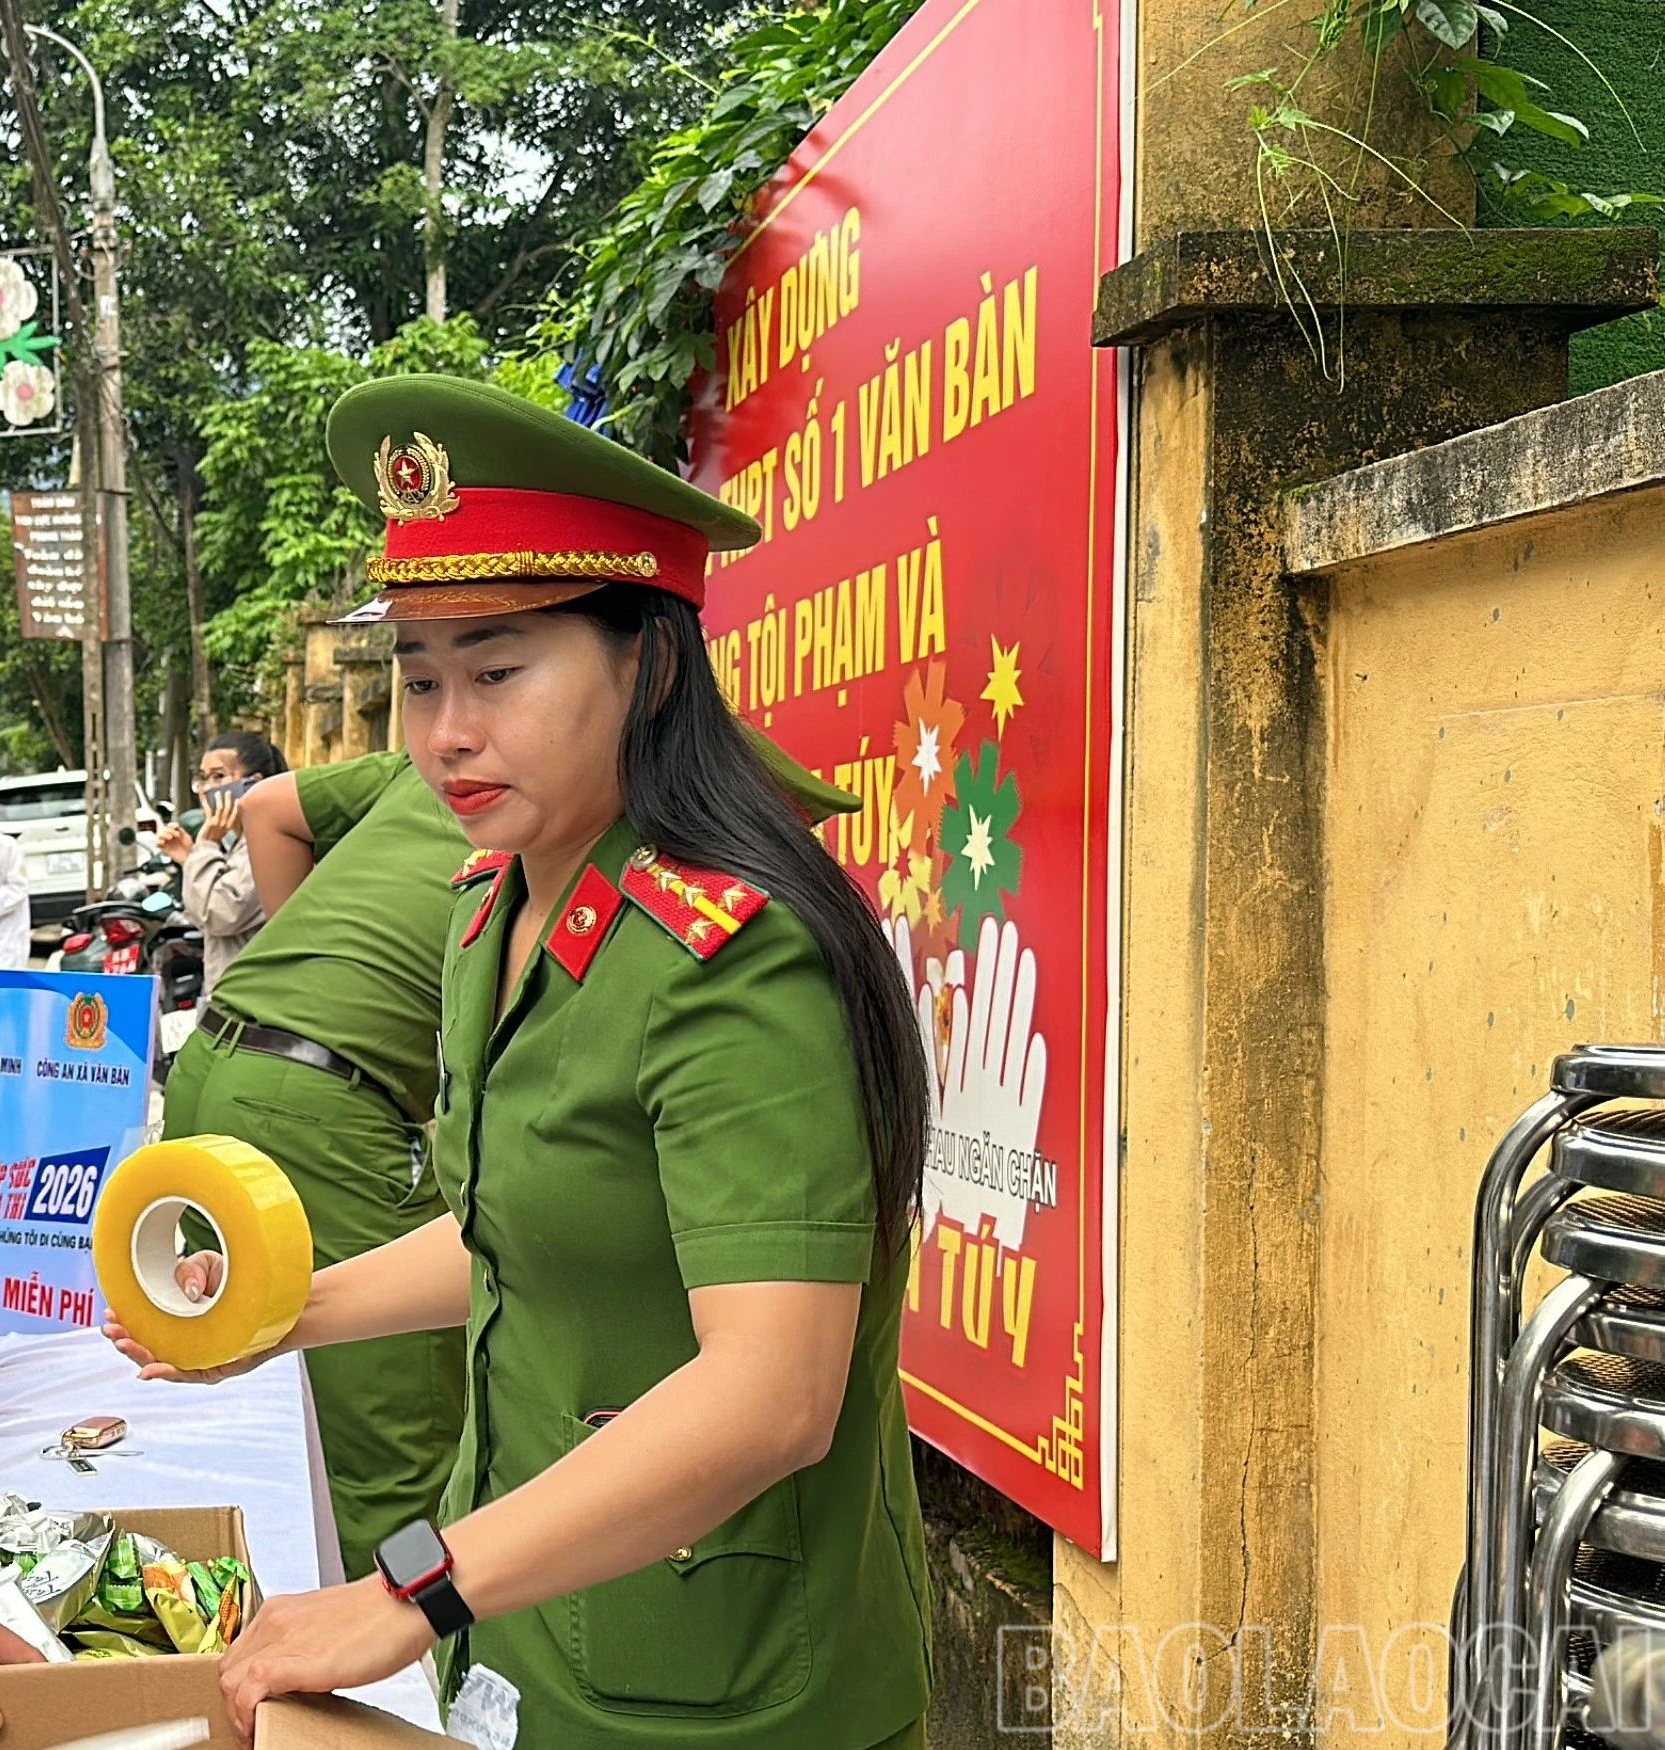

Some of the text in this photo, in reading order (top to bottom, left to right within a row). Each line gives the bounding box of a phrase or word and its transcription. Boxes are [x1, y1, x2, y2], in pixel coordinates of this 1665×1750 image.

[725, 207, 861, 413] XÂY DỰNG
[783, 376, 824, 531] SỐ
[831, 400, 845, 503] 1
[859, 337, 932, 489] VĂN
[943, 265, 1038, 443] BÀN
[747, 593, 786, 728] TỘI
[794, 563, 886, 707] PHẠM
[897, 515, 946, 664] VÀ
[834, 735, 896, 866] TÚY
[0, 1057, 22, 1074] MINH
[62, 1063, 74, 1079] AN
[5, 1193, 27, 1220] THI
[32, 1164, 98, 1218] 2026
[958, 1130, 1004, 1192] NGĂN
[1007, 1149, 1057, 1214] CHẶN
[3, 1270, 54, 1318] MIỄN
[59, 1288, 94, 1327] PHÍ
[937, 1223, 1037, 1368] TÚY
